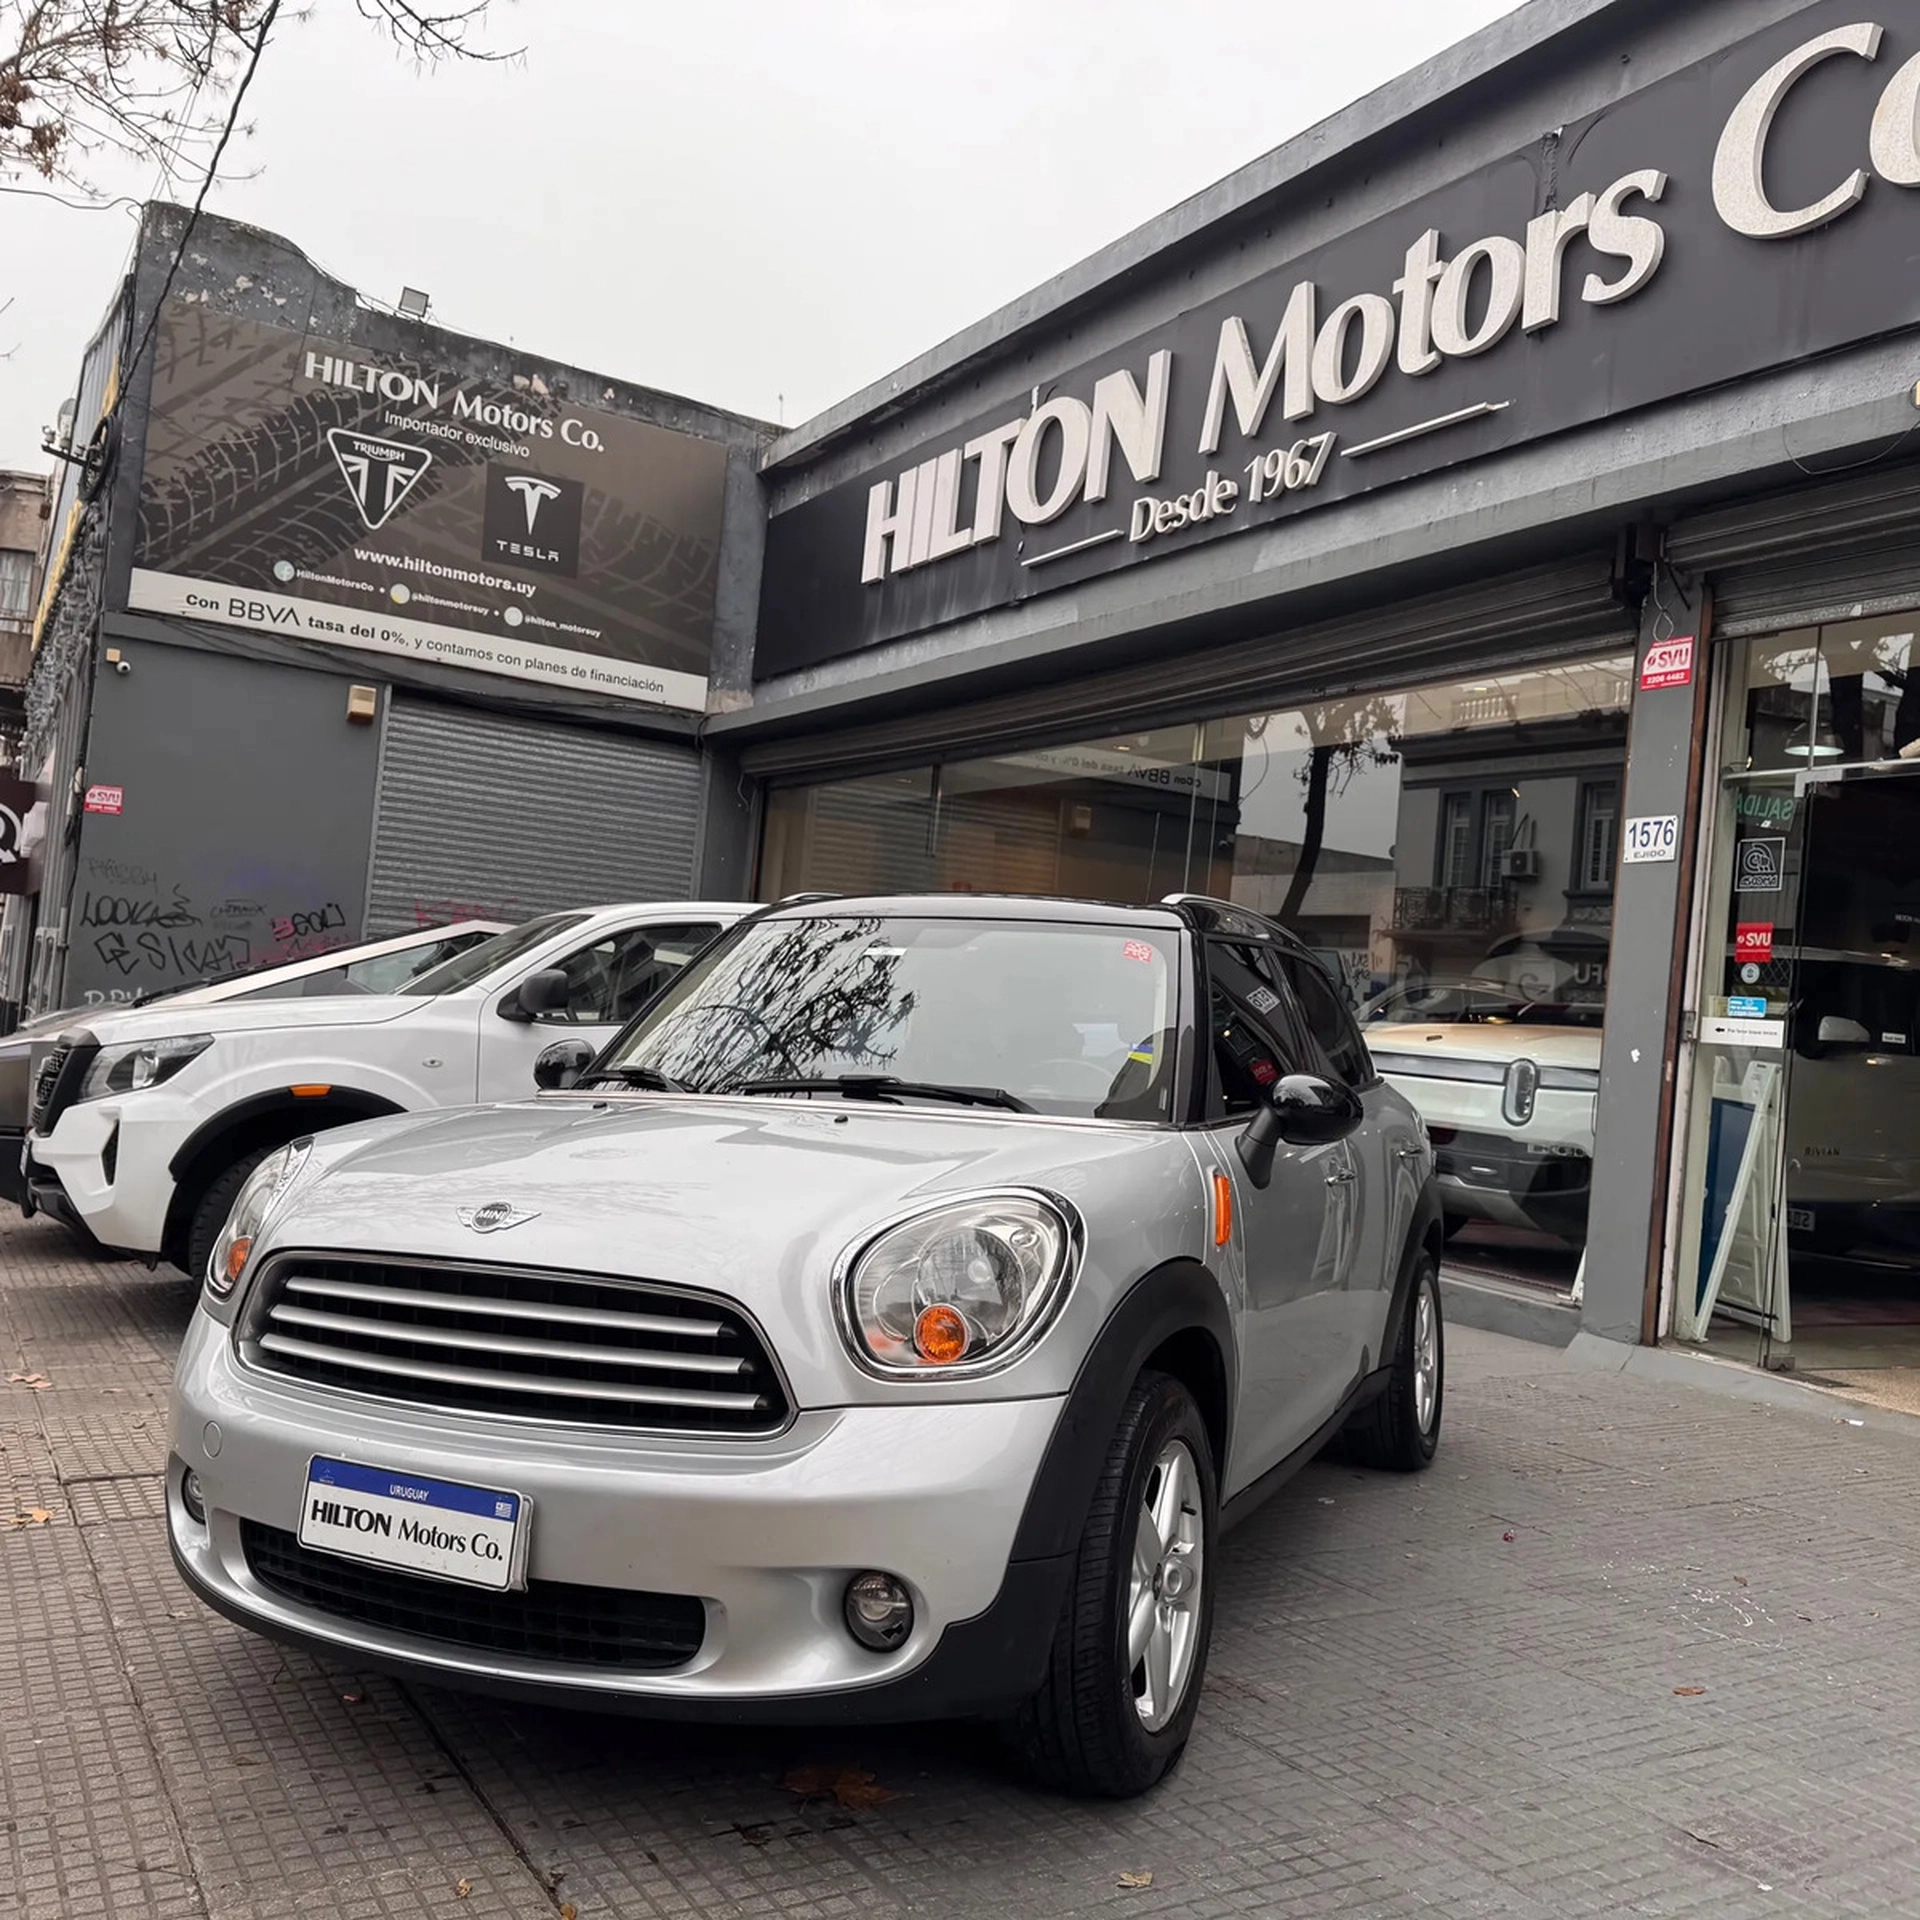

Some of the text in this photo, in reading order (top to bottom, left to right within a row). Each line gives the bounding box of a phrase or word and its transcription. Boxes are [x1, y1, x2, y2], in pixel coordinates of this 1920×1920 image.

[861, 349, 1171, 584] HILTON
[1198, 169, 1668, 455] Motors
[305, 351, 604, 452] HILTON Motors Co.
[353, 440, 405, 461] TRIUMPH
[385, 410, 530, 457] Importador exclusivo
[1130, 432, 1337, 543] Desde 1967
[497, 540, 559, 562] TESLA
[354, 547, 537, 598] www.hiltonmotors.uy
[186, 594, 219, 610] Con
[228, 598, 300, 626] BBVA
[308, 615, 345, 633] tasa
[350, 623, 375, 639] del
[414, 636, 424, 650] y
[426, 639, 493, 661] contamos
[497, 653, 521, 666] con
[525, 658, 567, 676] planes
[571, 665, 586, 678] de
[590, 668, 664, 693] financiación
[1658, 648, 1689, 668] SVU
[1629, 819, 1674, 848] 1576
[1746, 932, 1772, 947] SVU
[477, 1209, 508, 1220] MINI
[389, 1484, 429, 1501] URUGUAY
[311, 1499, 503, 1561] HILTON Motors Co.
